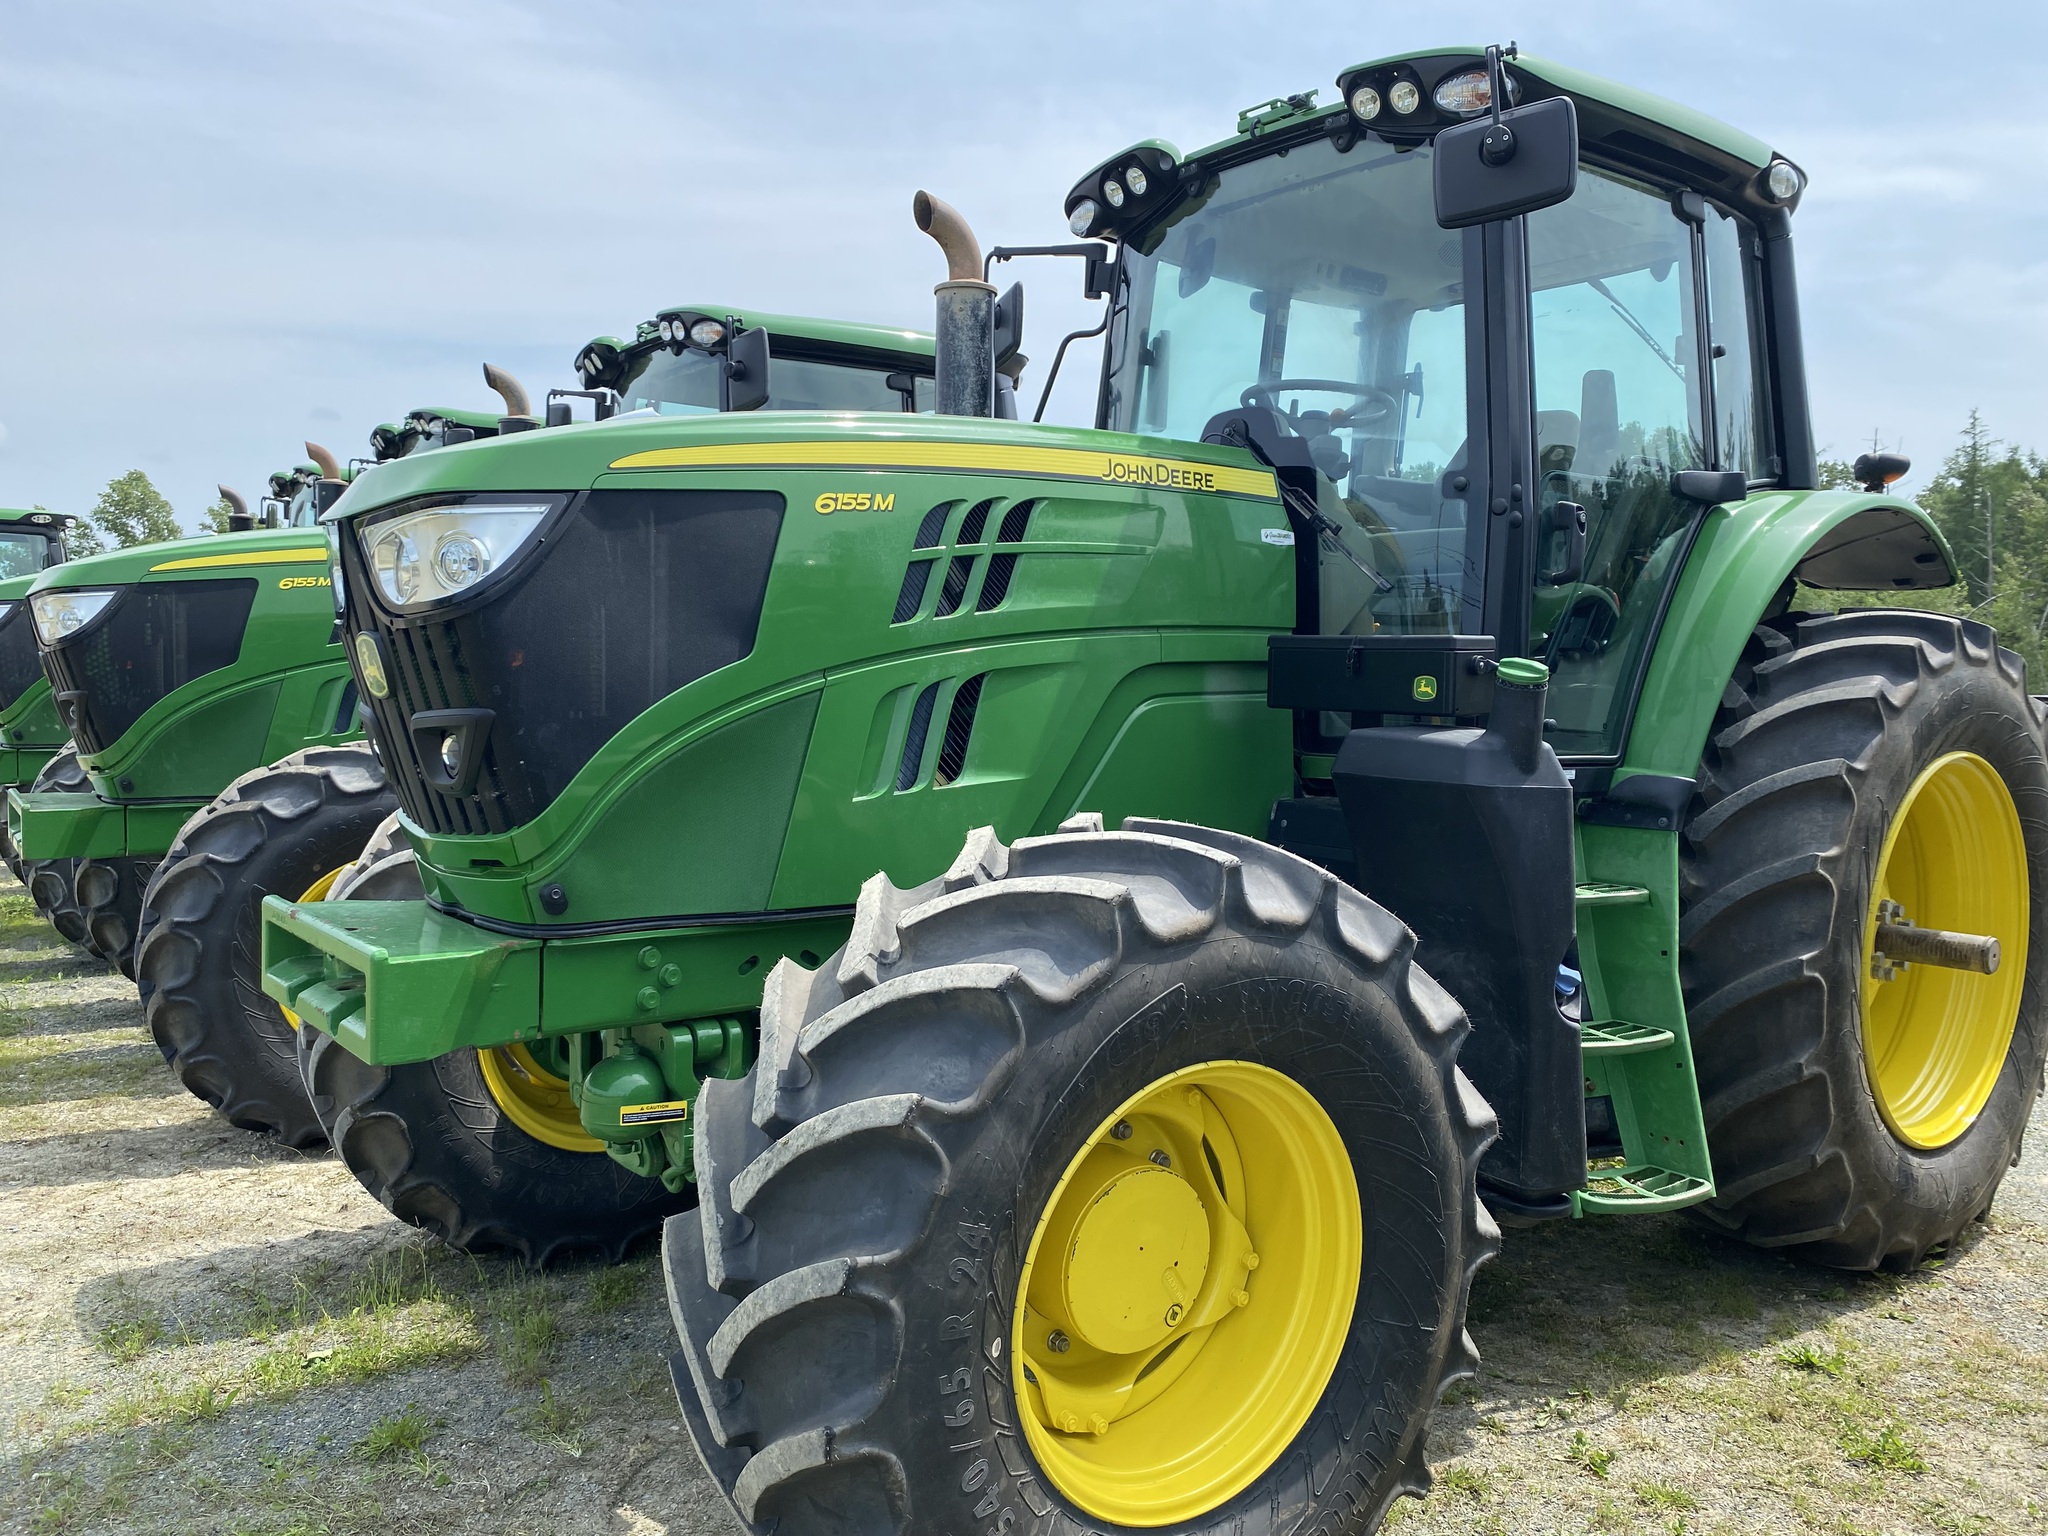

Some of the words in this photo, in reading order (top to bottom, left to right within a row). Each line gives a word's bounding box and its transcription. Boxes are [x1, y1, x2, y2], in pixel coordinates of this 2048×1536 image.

[1102, 458, 1152, 483] JOHN
[1156, 463, 1215, 489] DEERE
[645, 1103, 669, 1112] CAUTION
[949, 1220, 992, 1285] 24
[939, 1309, 976, 1342] R
